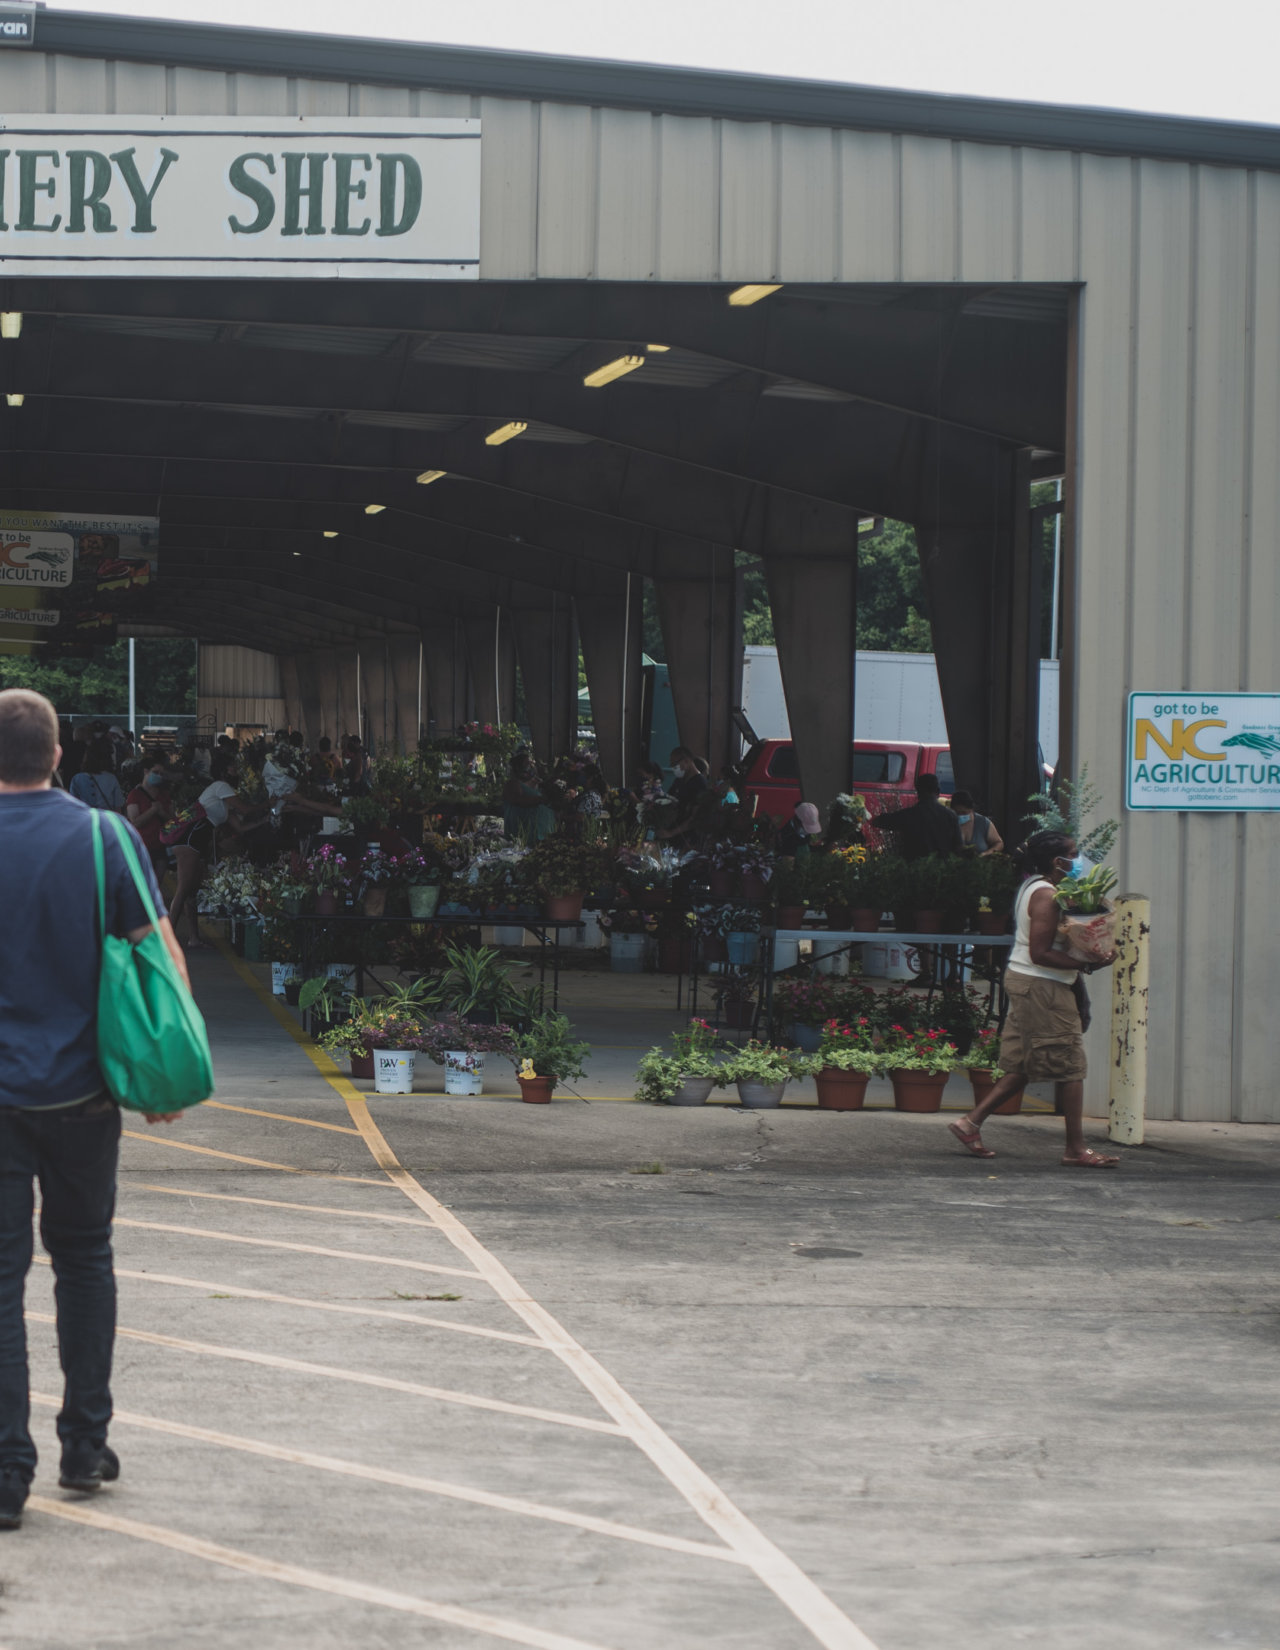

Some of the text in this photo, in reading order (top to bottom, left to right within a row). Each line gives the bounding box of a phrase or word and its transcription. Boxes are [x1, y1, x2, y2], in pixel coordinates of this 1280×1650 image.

[228, 151, 423, 237] SHED
[6, 518, 29, 527] YOU
[32, 519, 64, 529] WANT
[68, 520, 88, 529] THE
[92, 521, 119, 530] BEST
[6, 534, 17, 542] to
[19, 532, 32, 543] be
[1153, 702, 1220, 718] got to be
[1134, 718, 1228, 761] NC
